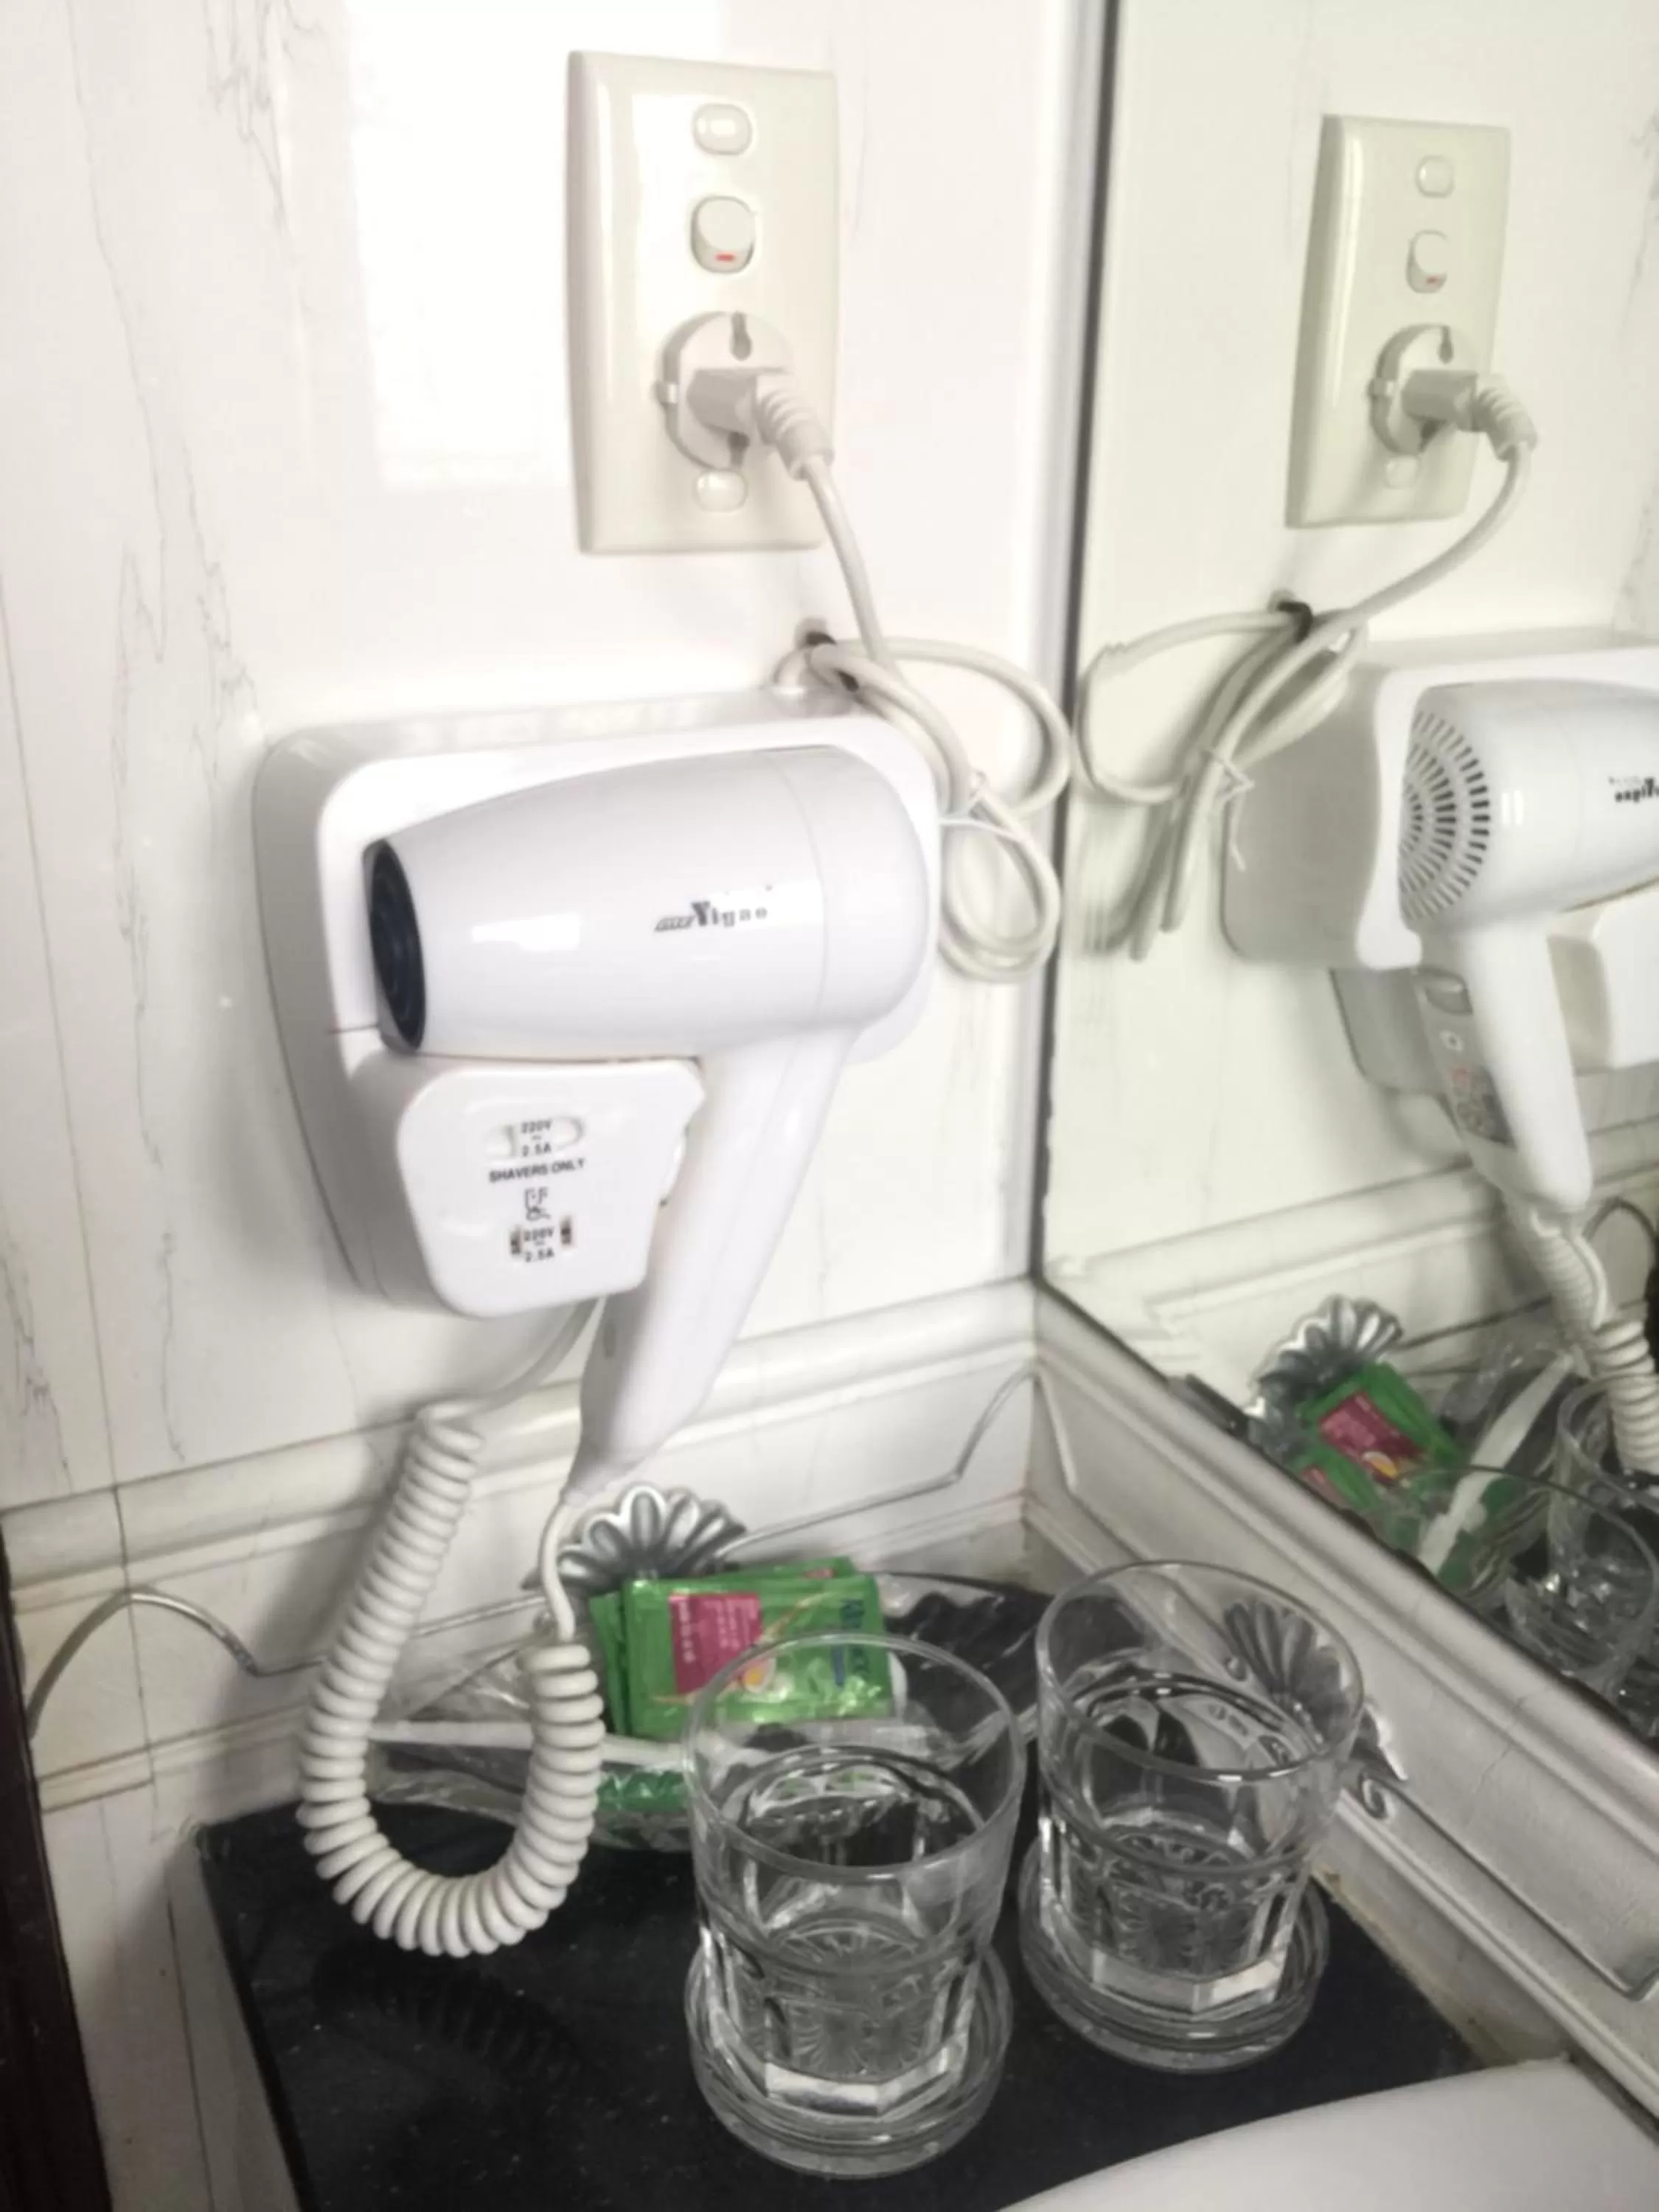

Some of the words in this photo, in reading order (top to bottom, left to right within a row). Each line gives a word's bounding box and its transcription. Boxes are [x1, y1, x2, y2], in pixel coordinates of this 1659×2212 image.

[522, 1120, 552, 1133] 220V
[490, 1164, 548, 1183] SHAVERS
[552, 1158, 583, 1174] ONLY
